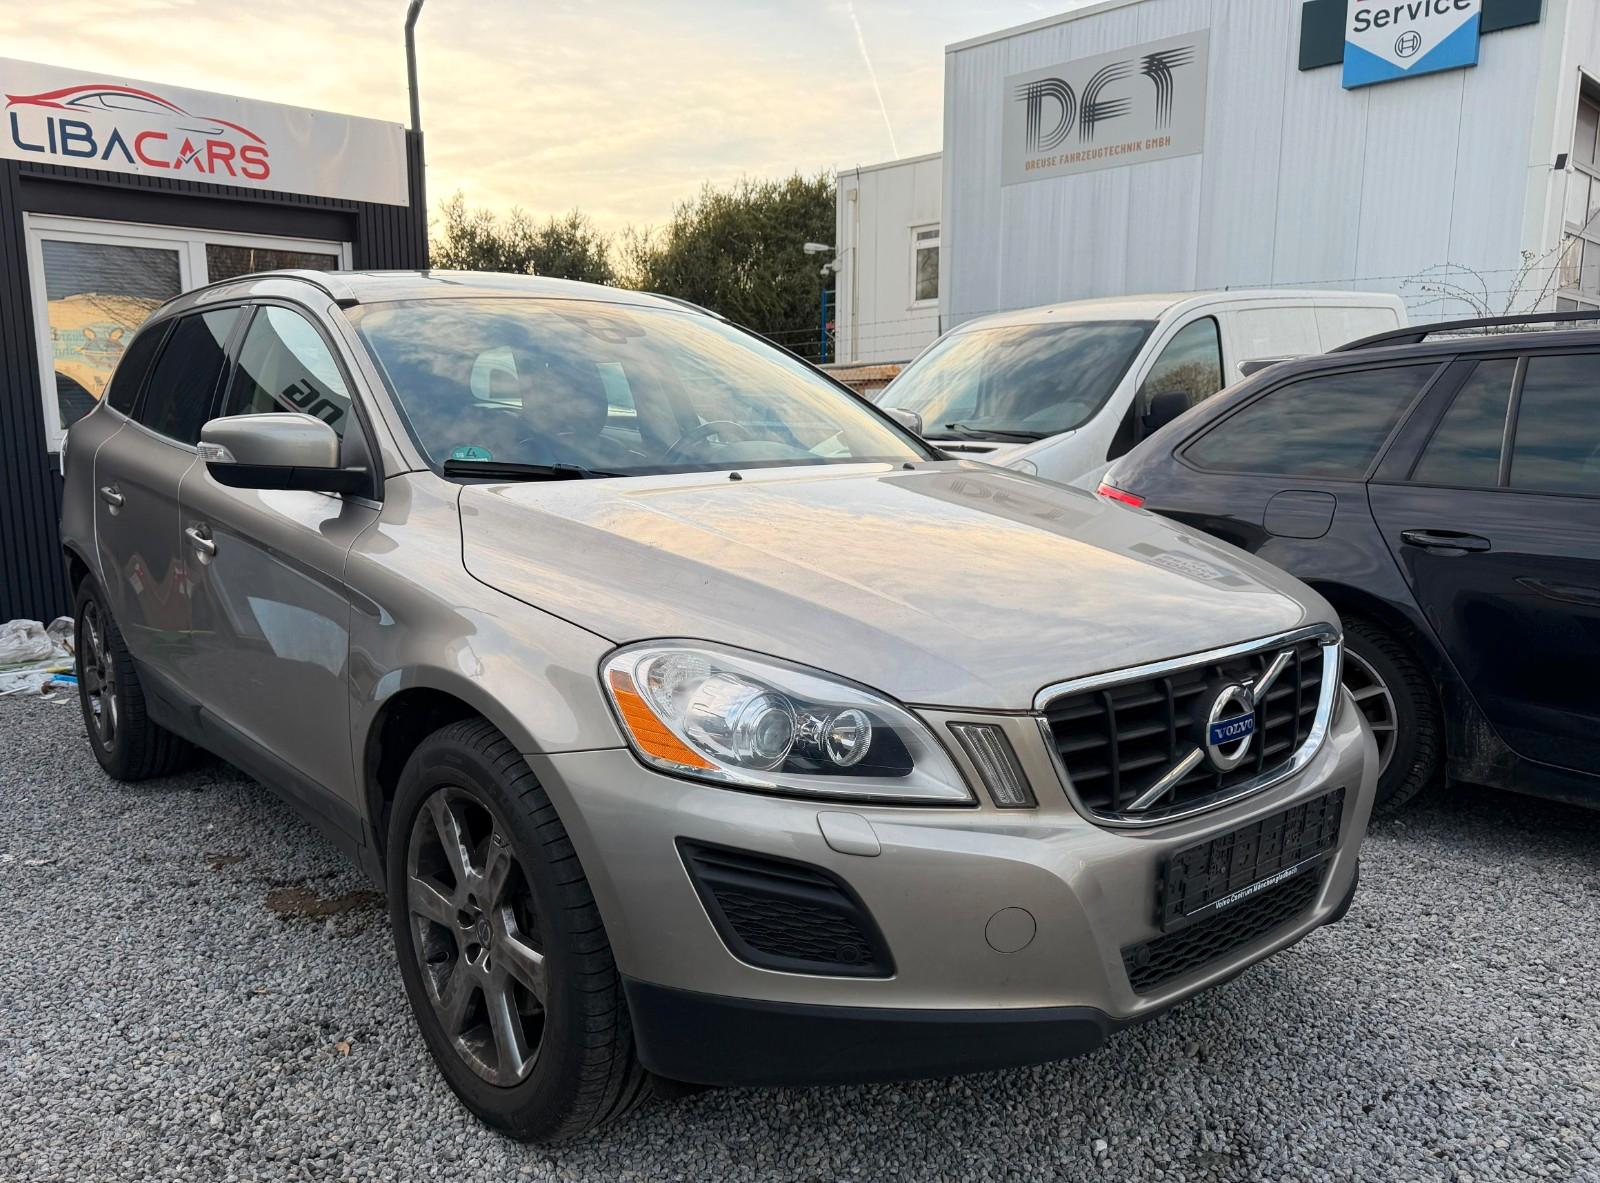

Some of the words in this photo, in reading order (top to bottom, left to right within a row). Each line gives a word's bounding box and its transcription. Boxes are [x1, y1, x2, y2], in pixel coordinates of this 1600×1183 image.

[1025, 155, 1057, 171] DREUSE
[1059, 140, 1143, 165] FAHRZEUGTECHNIK
[1145, 135, 1171, 150] GMBH
[1215, 719, 1253, 739] VOLVO
